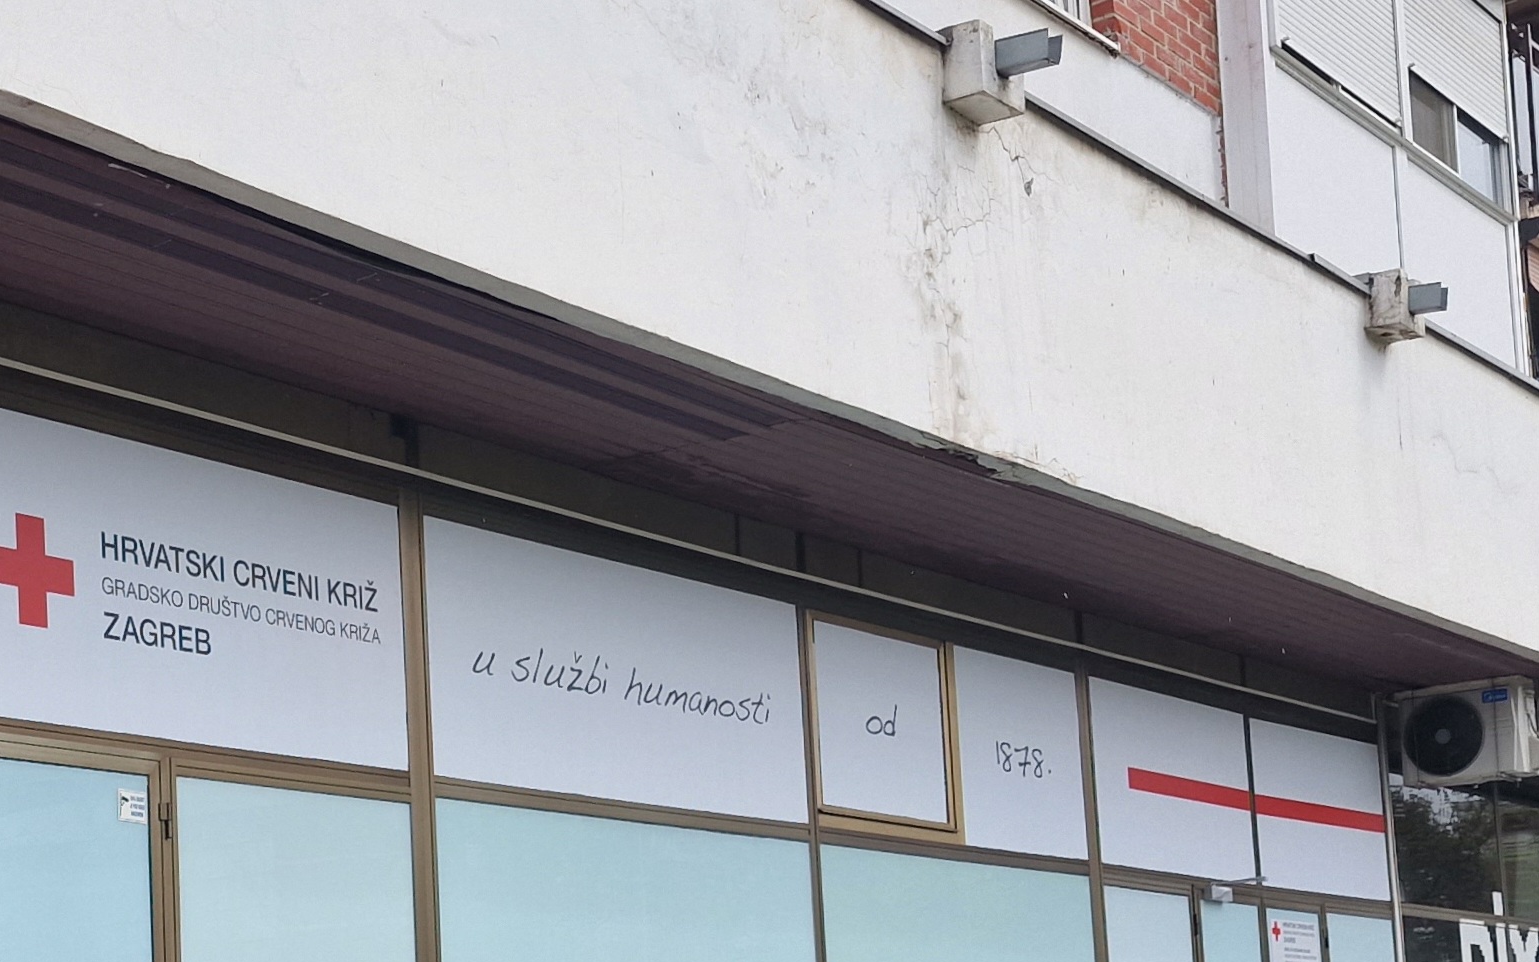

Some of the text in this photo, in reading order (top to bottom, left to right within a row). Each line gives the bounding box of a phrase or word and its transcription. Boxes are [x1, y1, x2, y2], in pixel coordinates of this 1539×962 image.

[100, 531, 379, 613] HRVATSKI CRVENI KRIŽ
[101, 577, 381, 645] GRADSKO DRUŠTVO CRVENOG KRIŽA
[103, 611, 211, 655] ZAGREB
[472, 648, 770, 726] u službi humanosti
[866, 704, 897, 737] od
[996, 741, 1053, 778] 1878.
